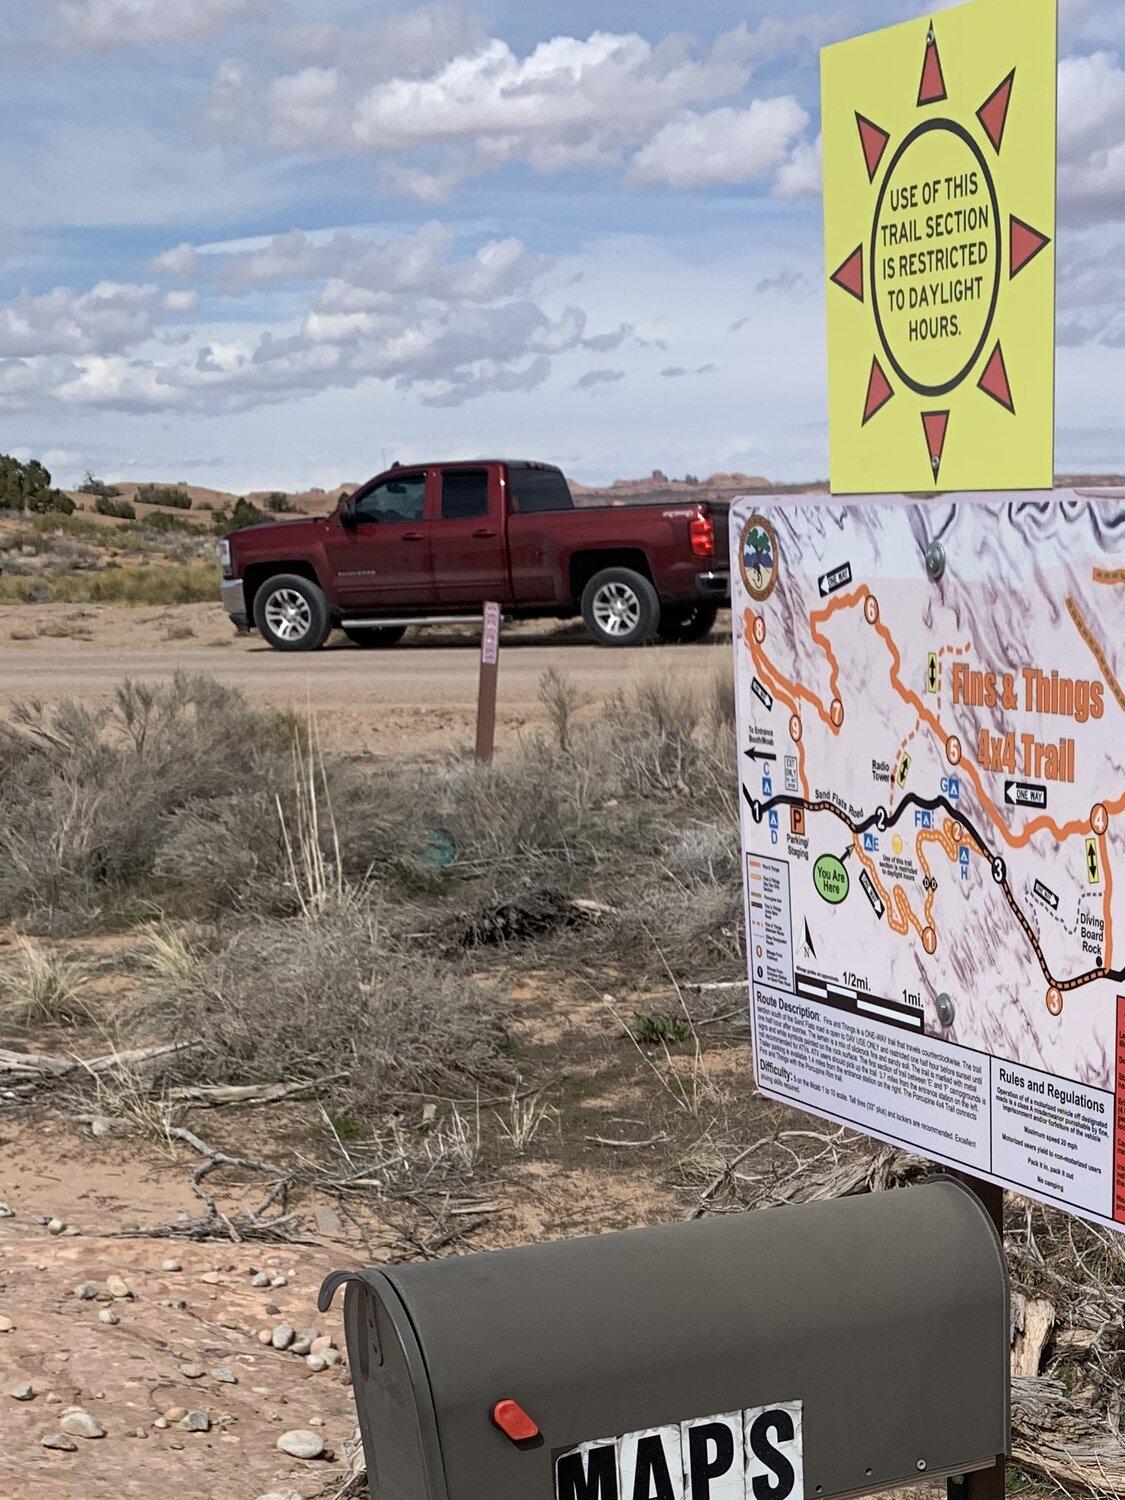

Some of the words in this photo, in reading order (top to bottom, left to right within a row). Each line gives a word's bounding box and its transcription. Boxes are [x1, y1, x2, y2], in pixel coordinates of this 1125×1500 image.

[891, 184, 918, 213] USE
[922, 180, 941, 205] OF
[944, 173, 978, 200] THIS
[881, 222, 921, 246] TRAIL
[926, 205, 990, 239] SECTION
[883, 259, 895, 279] IS
[899, 241, 988, 276] RESTRICTED
[888, 290, 905, 312] TO
[909, 277, 983, 309] DAYLIGHT
[909, 314, 961, 342] HOURS.
[828, 574, 837, 588] ONE
[837, 571, 849, 584] WAY
[867, 602, 876, 619] 6
[755, 620, 762, 639] 8
[952, 662, 996, 708] Fins
[1001, 673, 1018, 710] &
[1022, 667, 1104, 724] Things
[833, 703, 841, 723] 7
[754, 727, 774, 737] Entrance
[792, 718, 799, 737] 9
[950, 740, 957, 762] 5
[976, 729, 1016, 774] 4x4
[1021, 733, 1075, 783] Trail
[763, 762, 770, 775] C
[786, 758, 795, 768] EXIT
[786, 767, 796, 778] ONLY
[872, 760, 890, 772] Radio
[872, 770, 890, 783] Tower
[941, 778, 948, 793] G
[815, 789, 830, 802] Sand
[832, 793, 847, 810] Flats
[848, 804, 864, 818] Road
[1017, 788, 1028, 800] ONE
[1030, 790, 1042, 801] WAY
[755, 804, 759, 820] 1
[793, 811, 801, 831] P
[877, 809, 885, 830] 2
[915, 811, 921, 827] F
[1093, 808, 1103, 831] 4
[772, 830, 778, 844] D
[953, 823, 961, 840] 2
[787, 845, 809, 861] Staging
[874, 837, 880, 851] E
[817, 865, 831, 881] You
[832, 870, 845, 882] Are
[961, 866, 968, 880] H
[994, 861, 1002, 882] 3
[823, 878, 840, 895] Here
[1080, 913, 1104, 933] Diving
[926, 932, 932, 951] 1
[1080, 929, 1104, 942] Board
[804, 945, 810, 958] N
[1082, 941, 1101, 955] Rock
[842, 971, 871, 991] 1/2mi.
[756, 991, 776, 1006] Route
[778, 998, 820, 1022] Description:
[902, 989, 924, 1007] 1mi.
[1049, 991, 1060, 1014] 3
[999, 1068, 1024, 1087] Rules
[1027, 1077, 1044, 1094] and
[1046, 1084, 1105, 1115] Regulations
[996, 1086, 1017, 1099] Operation
[1033, 1099, 1056, 1111] motorized
[1056, 1106, 1073, 1116] vehicle
[1081, 1114, 1107, 1129] designated
[1034, 1107, 1064, 1121] misdemeanor
[1091, 1125, 1097, 1134] by
[1024, 1126, 1045, 1138] Maximum
[1046, 1134, 1059, 1144] speed
[1060, 1138, 1066, 1146] 20
[1067, 1141, 1078, 1152] mph
[1084, 1132, 1101, 1142] vehicle
[1001, 1133, 1023, 1146] Motorized
[1024, 1142, 1036, 1150] users
[1037, 1145, 1048, 1155] yield
[1054, 1152, 1087, 1168] non-motorized
[1088, 1164, 1101, 1174] users
[1027, 1157, 1038, 1166] Pack
[1049, 1165, 1061, 1175] pack
[1065, 1171, 1074, 1179] out
[1037, 1175, 1043, 1184] No
[1044, 1179, 1063, 1192] camping
